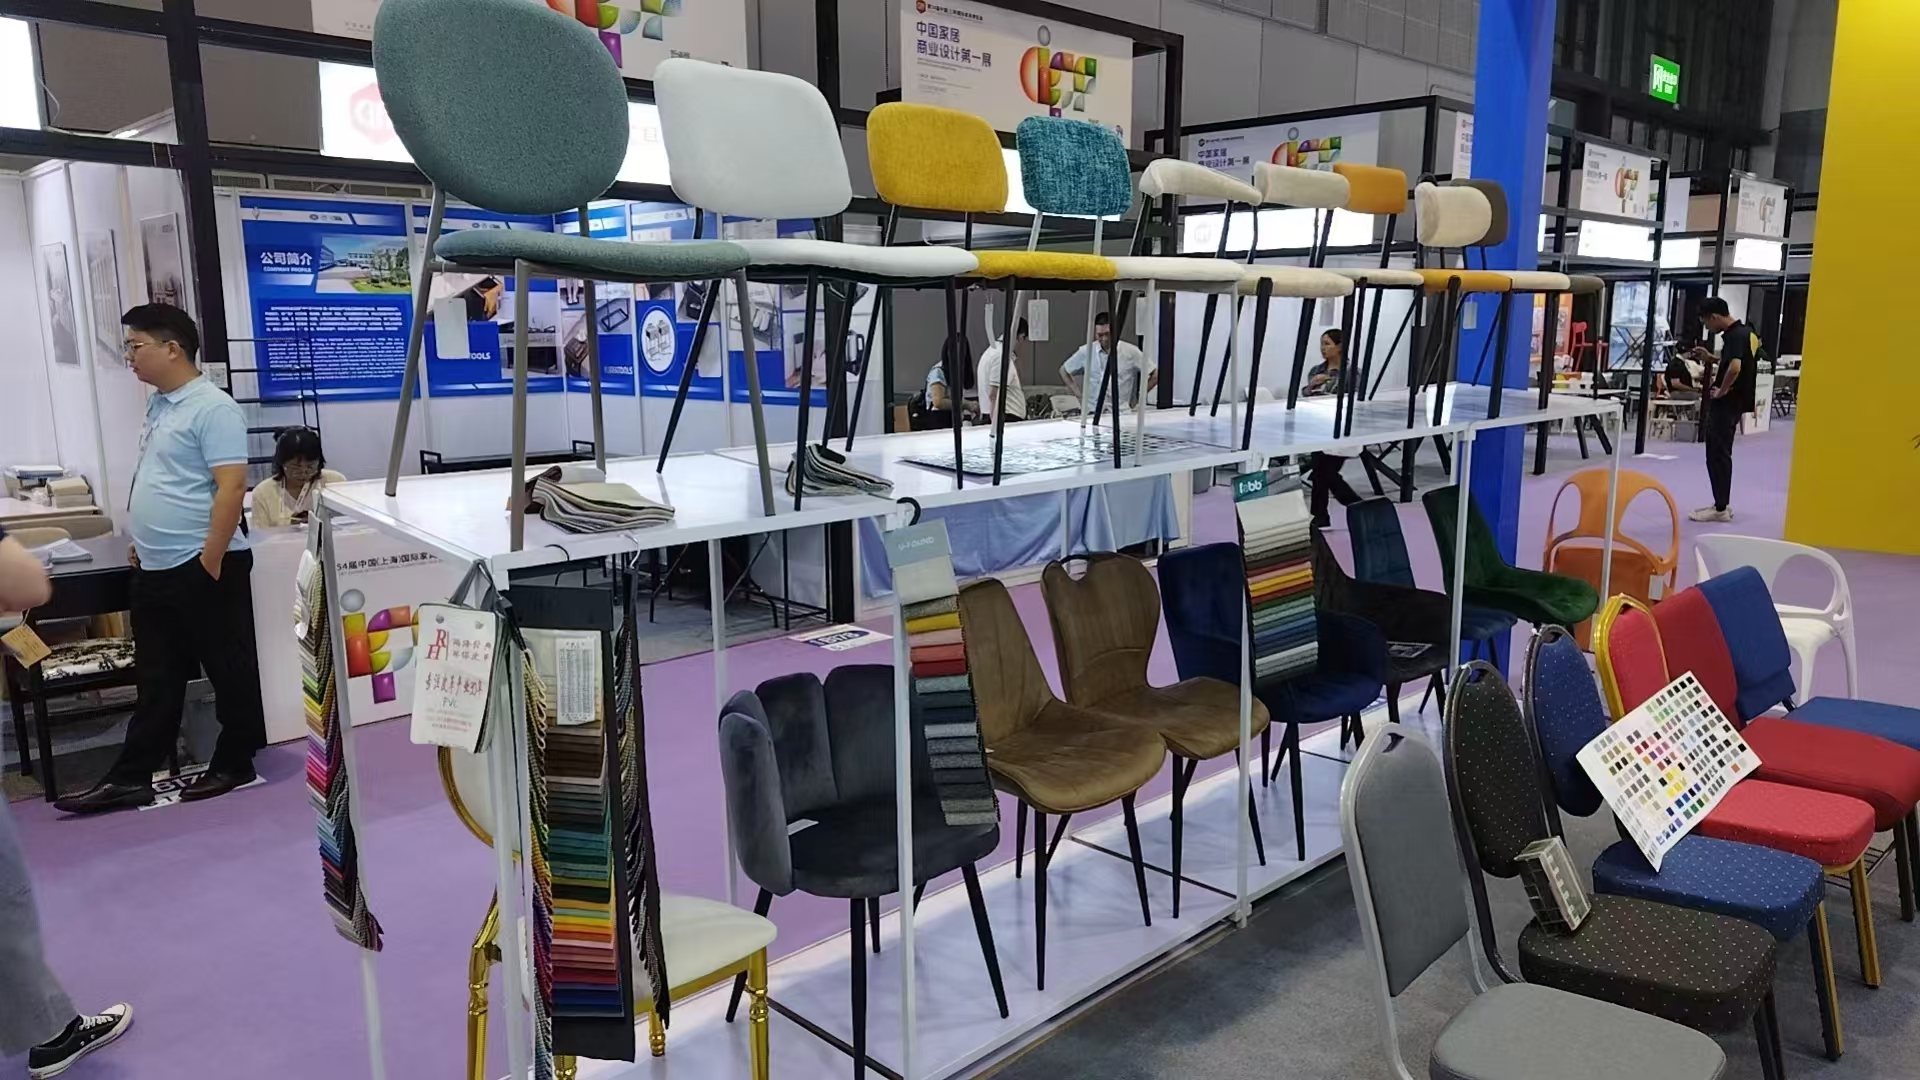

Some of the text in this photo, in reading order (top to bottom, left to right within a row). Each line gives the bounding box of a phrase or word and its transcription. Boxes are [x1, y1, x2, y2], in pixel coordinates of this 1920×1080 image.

[916, 21, 960, 43] 中国家居
[917, 39, 992, 67] 商业设计第一展
[260, 252, 313, 265] 公司简介
[151, 772, 206, 793] B17
